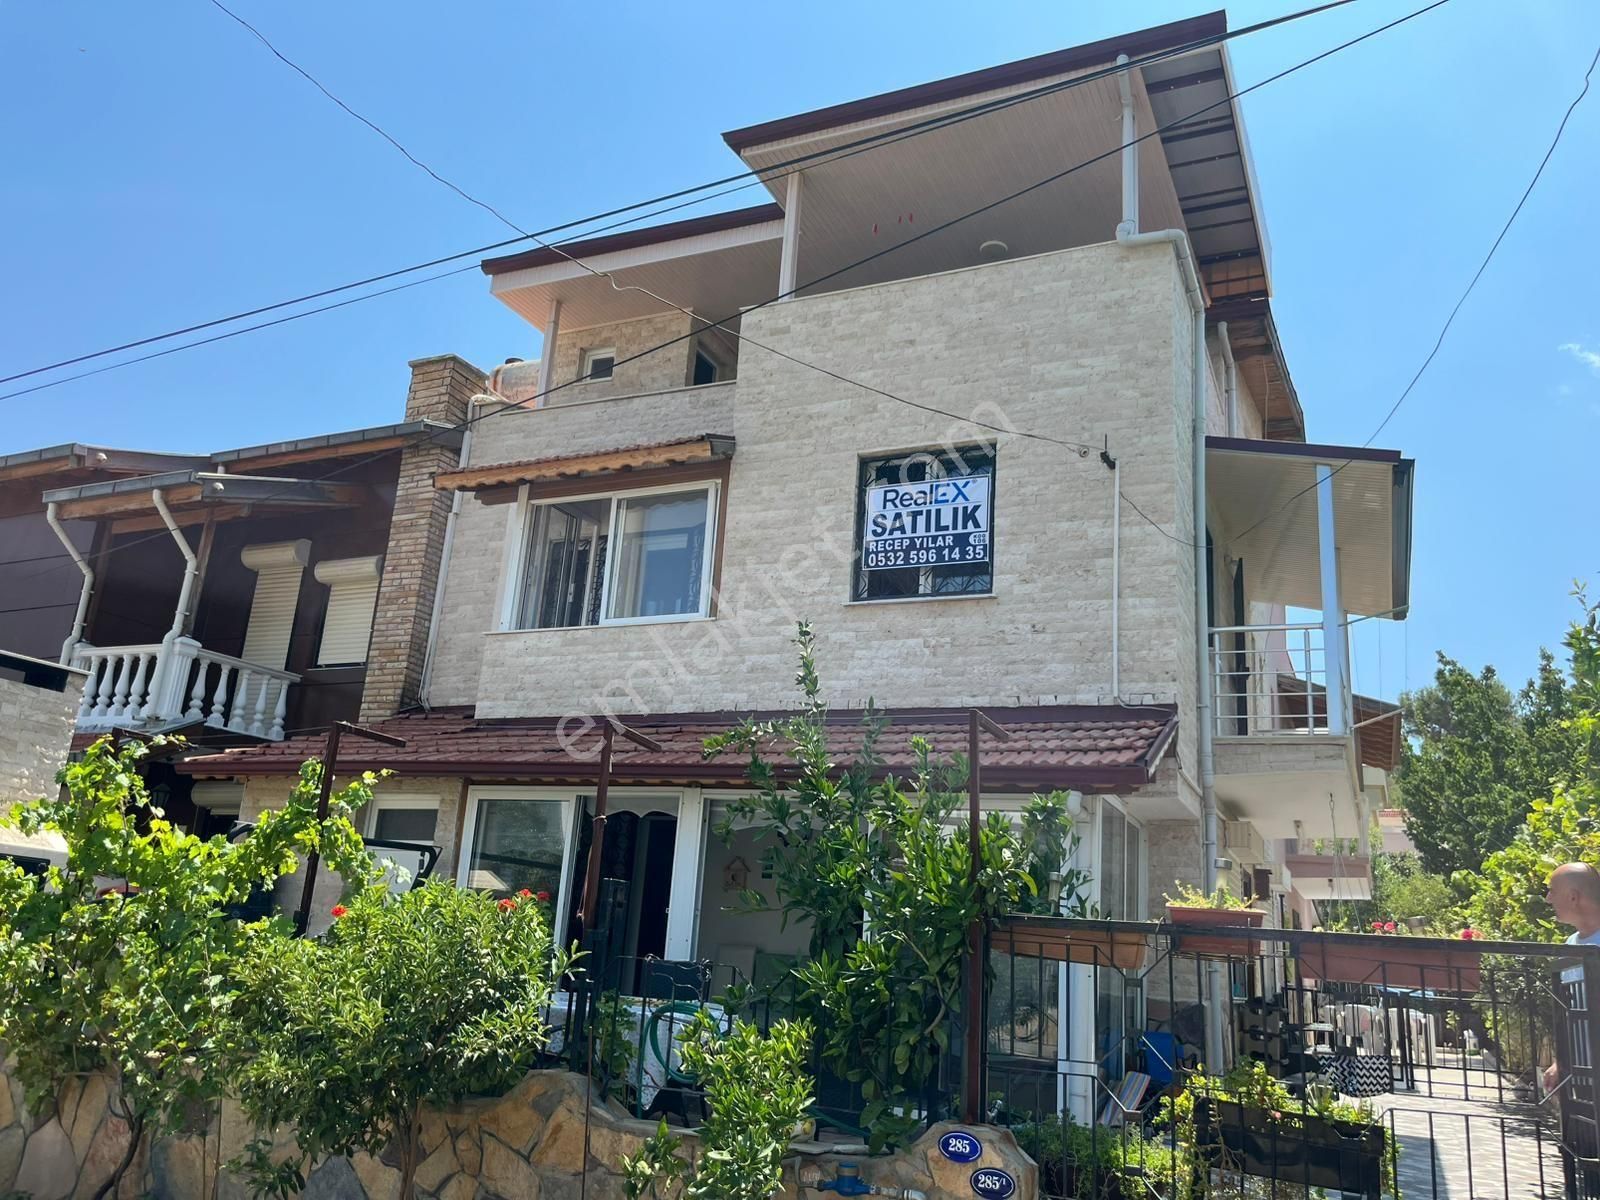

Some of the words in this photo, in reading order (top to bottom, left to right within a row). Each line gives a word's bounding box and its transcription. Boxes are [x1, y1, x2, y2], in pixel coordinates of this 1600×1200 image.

[882, 480, 971, 510] RealEX
[871, 504, 983, 538] SATILIK
[869, 538, 910, 552] RECEP
[914, 536, 954, 549] YILAR
[868, 551, 905, 567] 0532
[909, 549, 937, 564] 596
[942, 547, 960, 562] 14
[965, 545, 984, 560] 35
[948, 1137, 970, 1153] 285
[977, 1173, 1007, 1190] 285/1
